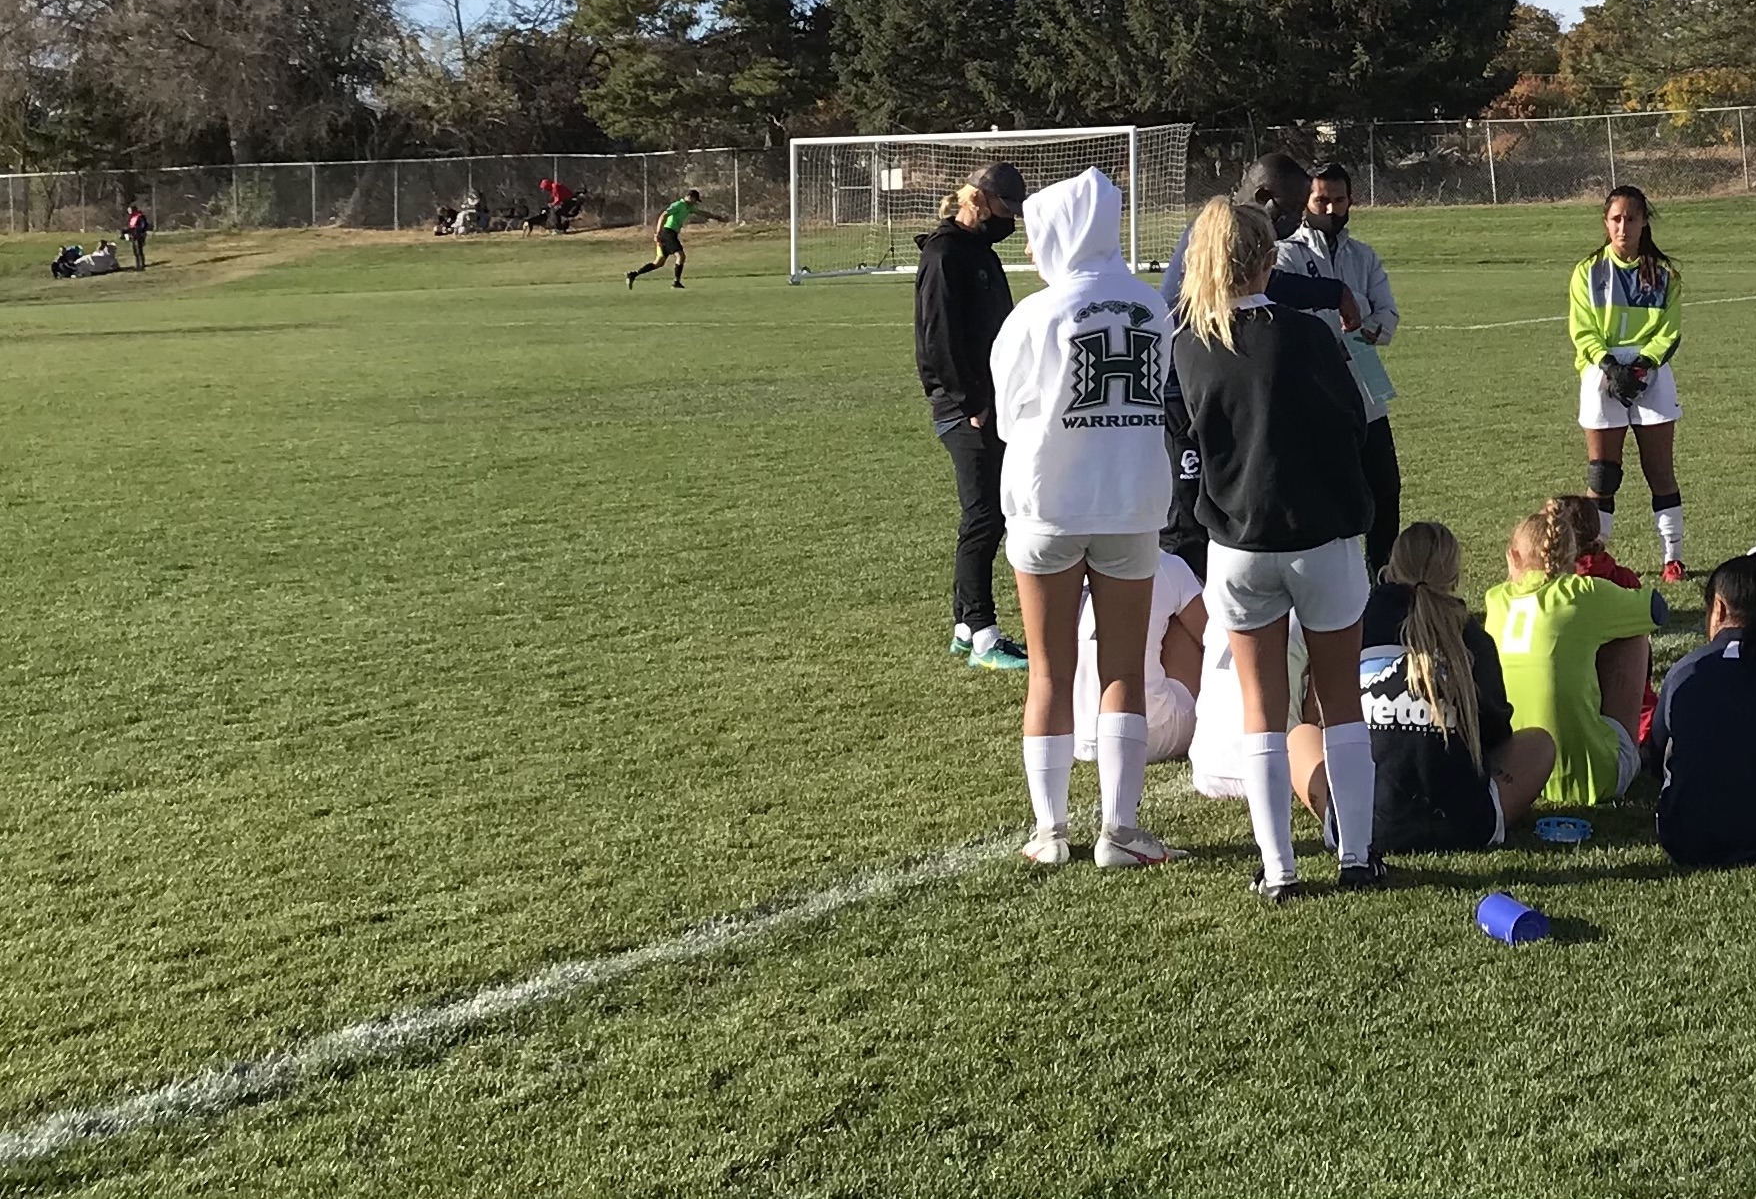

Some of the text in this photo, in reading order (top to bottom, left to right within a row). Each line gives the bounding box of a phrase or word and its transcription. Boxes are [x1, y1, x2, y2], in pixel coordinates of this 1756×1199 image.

[1063, 326, 1165, 415] H
[1180, 449, 1200, 474] CC
[1501, 594, 1537, 654] 0
